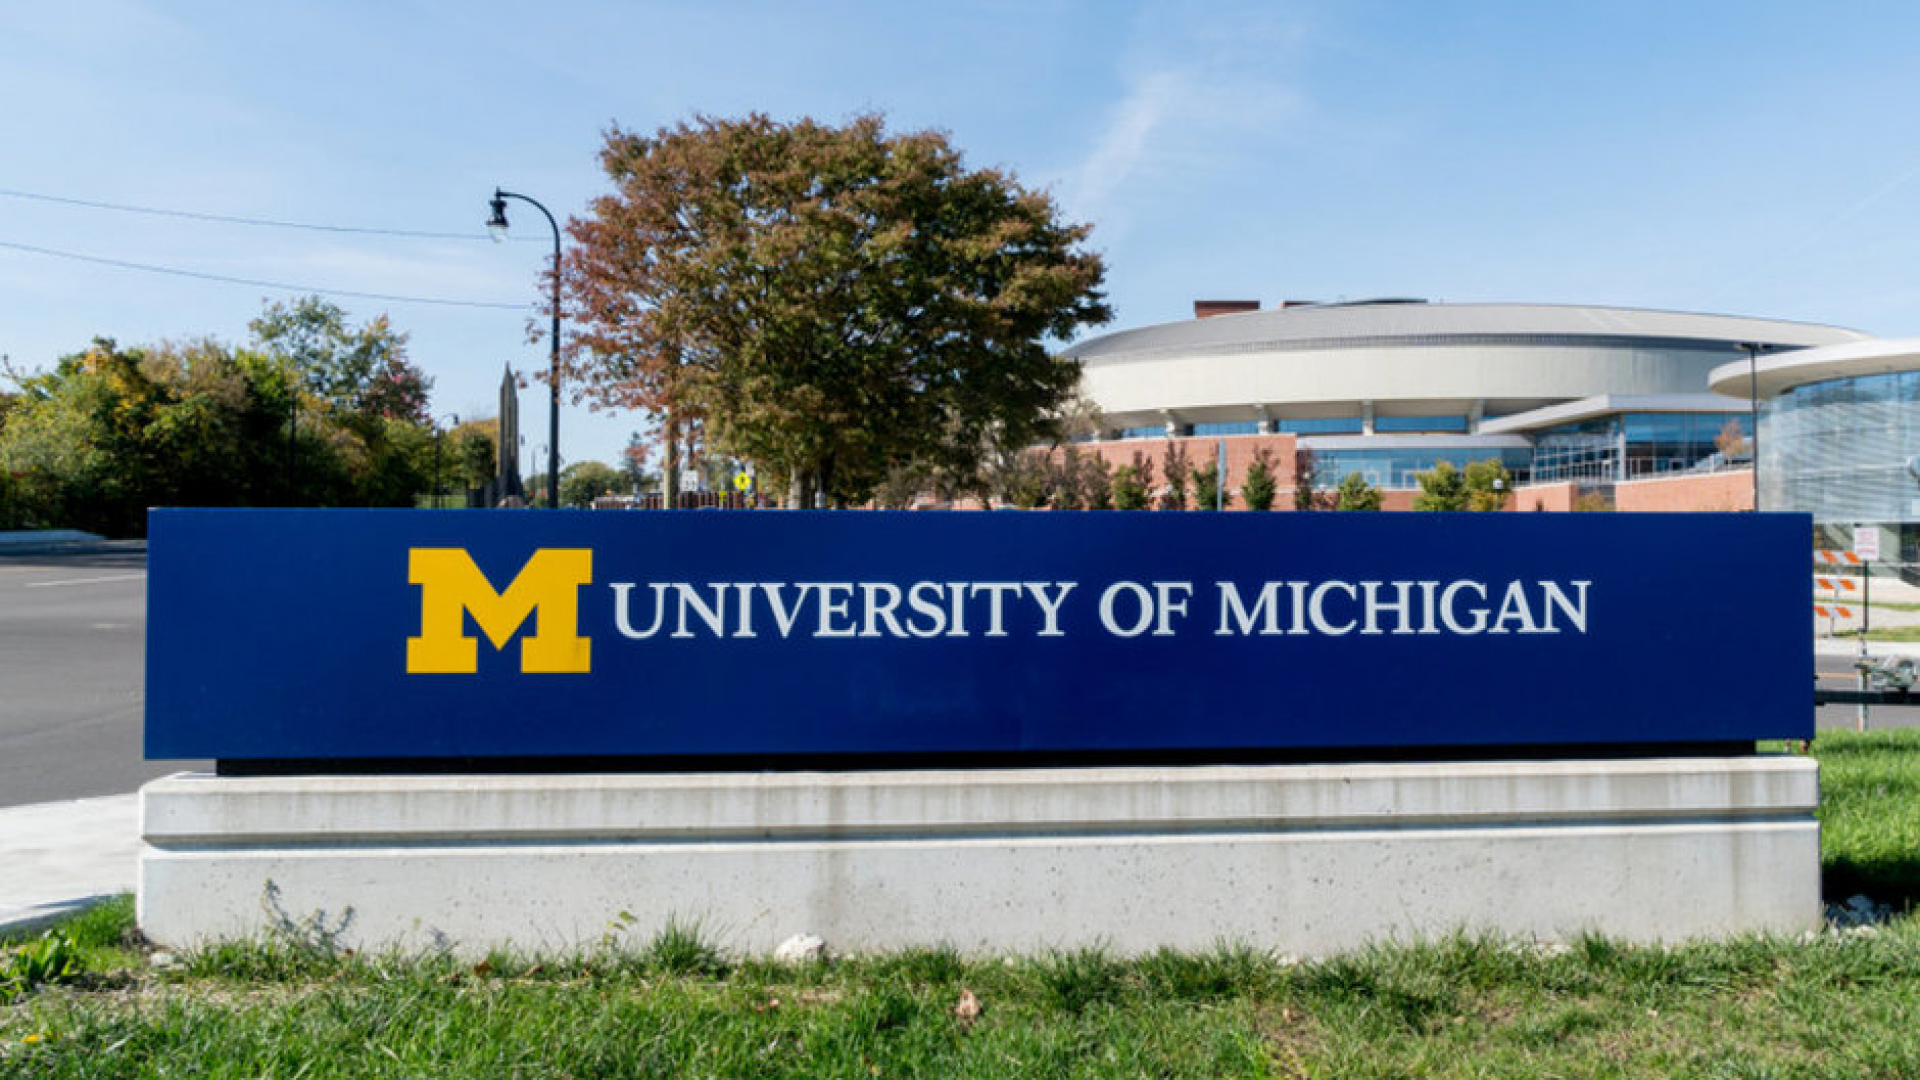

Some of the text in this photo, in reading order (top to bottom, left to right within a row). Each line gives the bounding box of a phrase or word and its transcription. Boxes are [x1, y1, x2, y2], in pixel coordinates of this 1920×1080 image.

[406, 547, 1591, 674] M UNIVERSITY OF MICHIGAN
